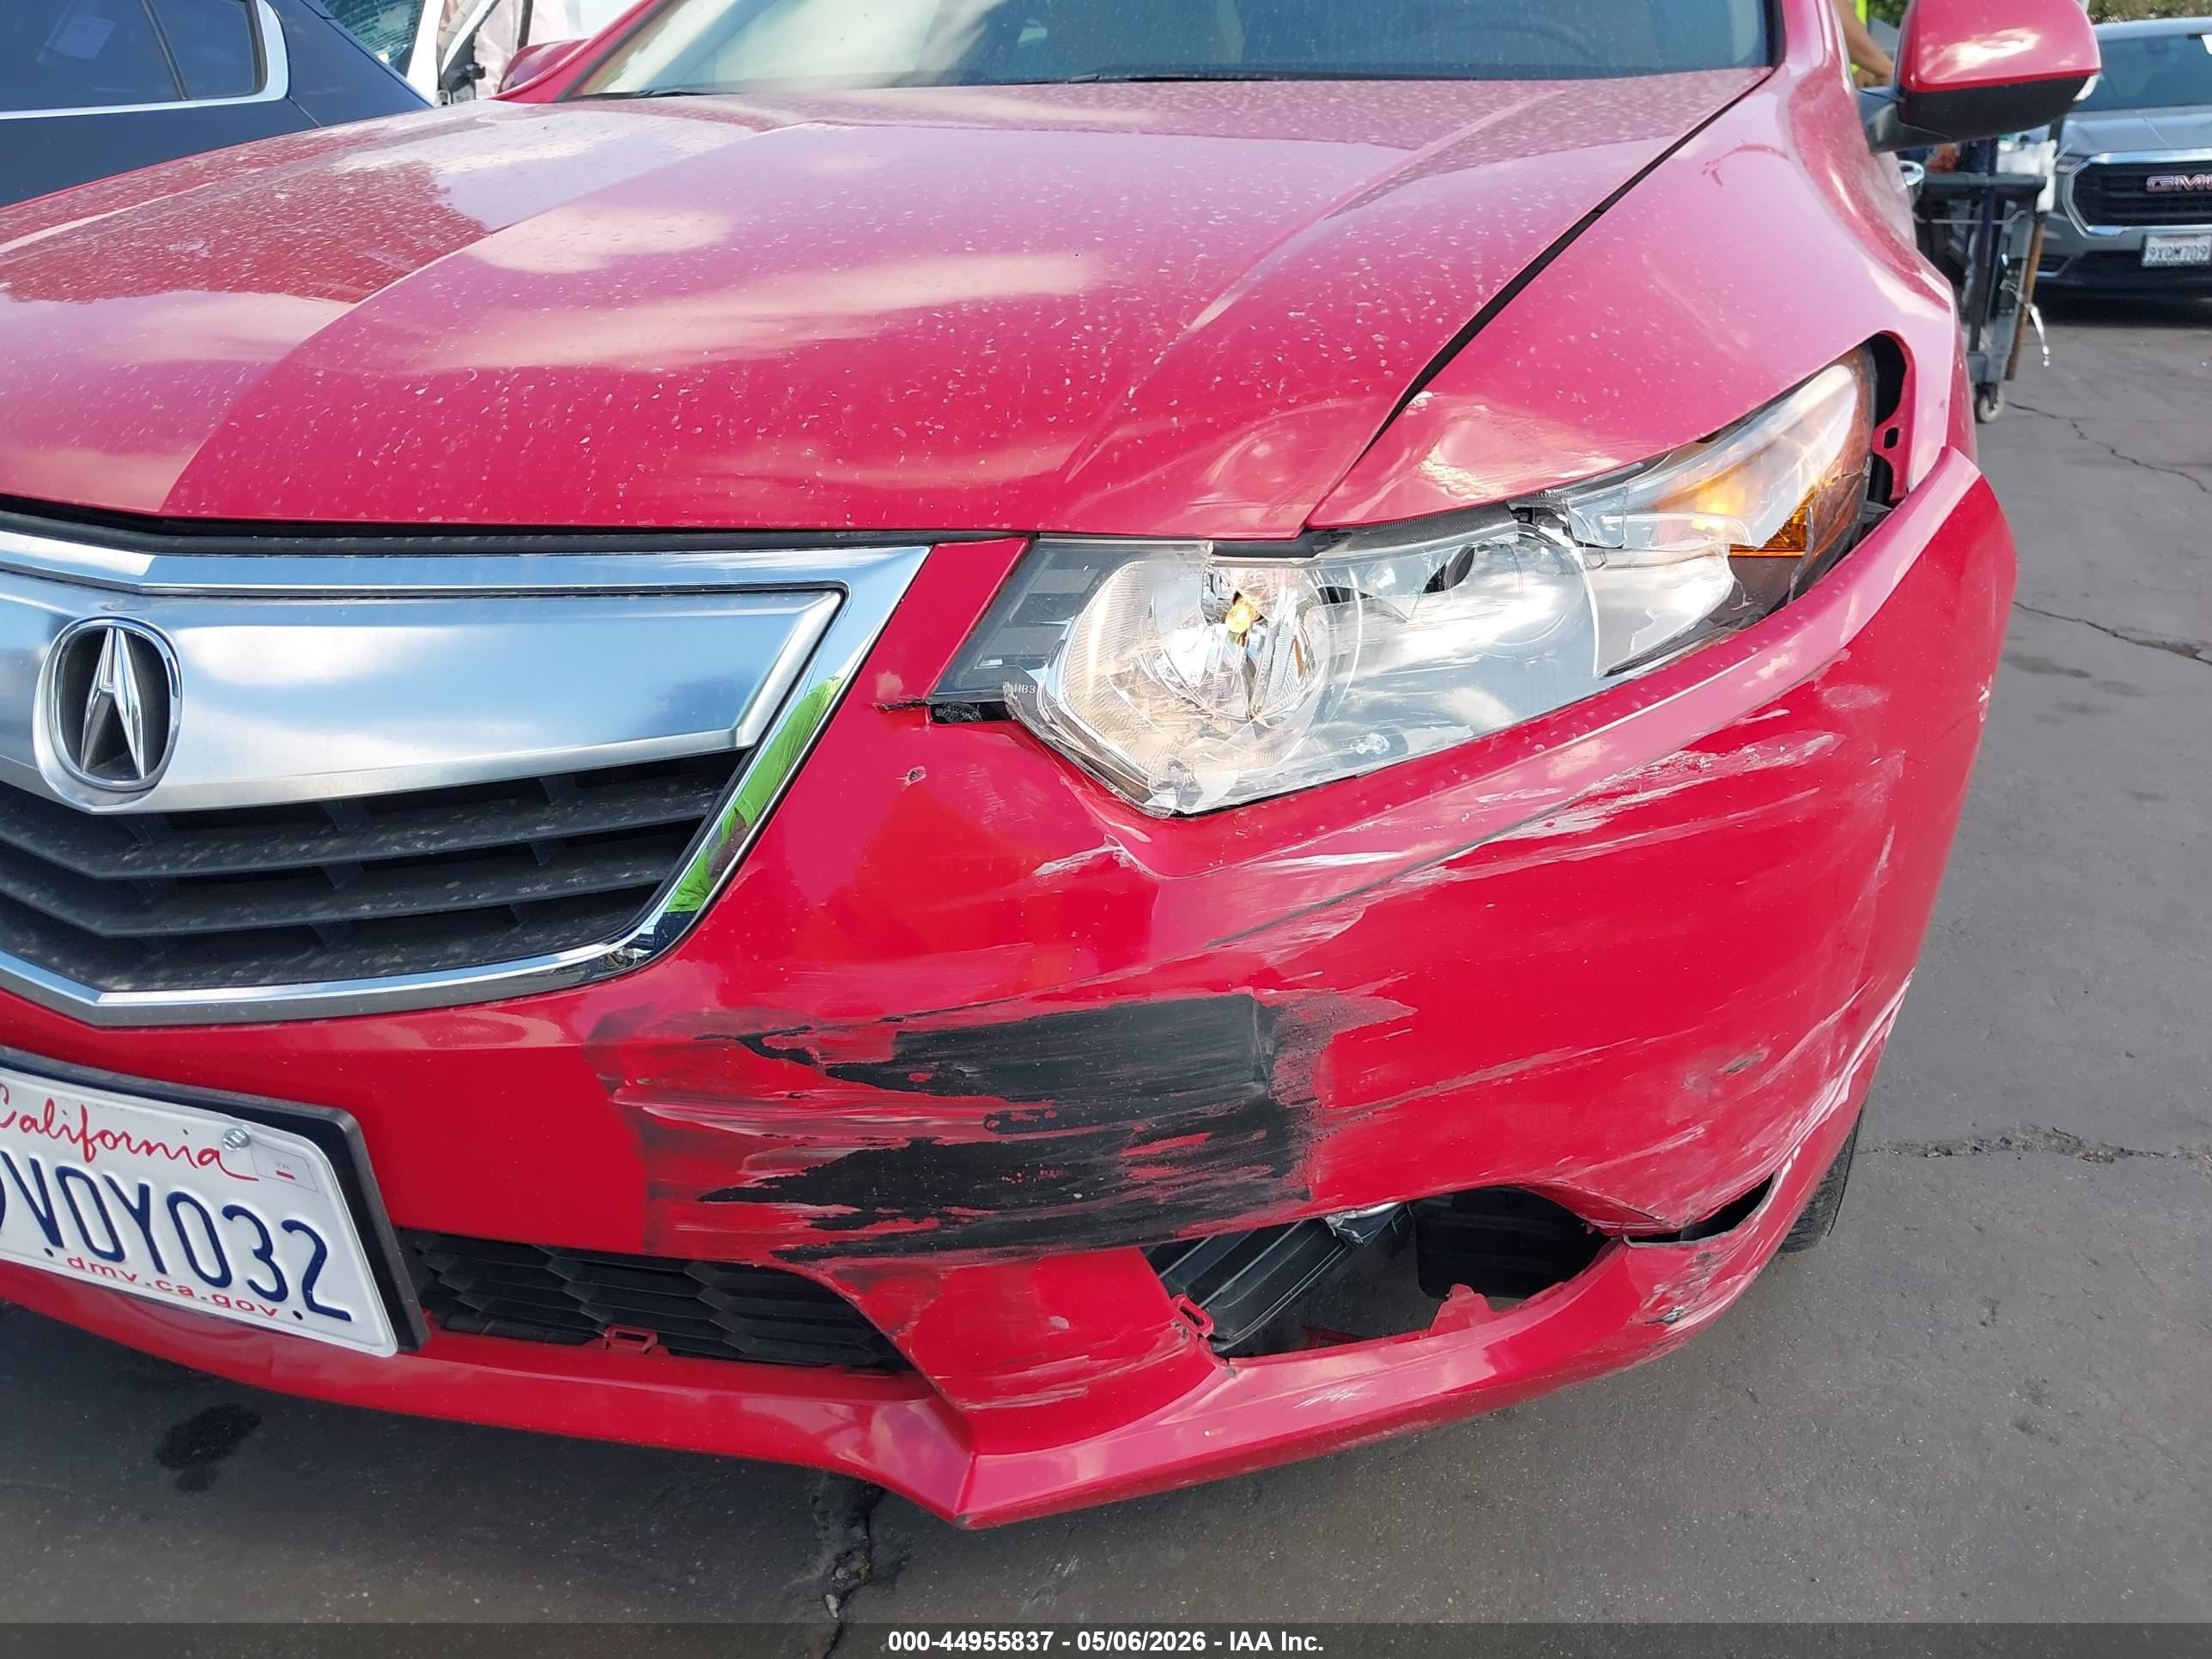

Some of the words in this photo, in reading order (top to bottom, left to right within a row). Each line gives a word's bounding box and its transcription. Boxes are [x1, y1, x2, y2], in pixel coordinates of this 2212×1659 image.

[2147, 174, 2212, 192] GM
[0, 1150, 352, 1322] VOY032
[67, 1256, 277, 1317] dmv.ca.gov
